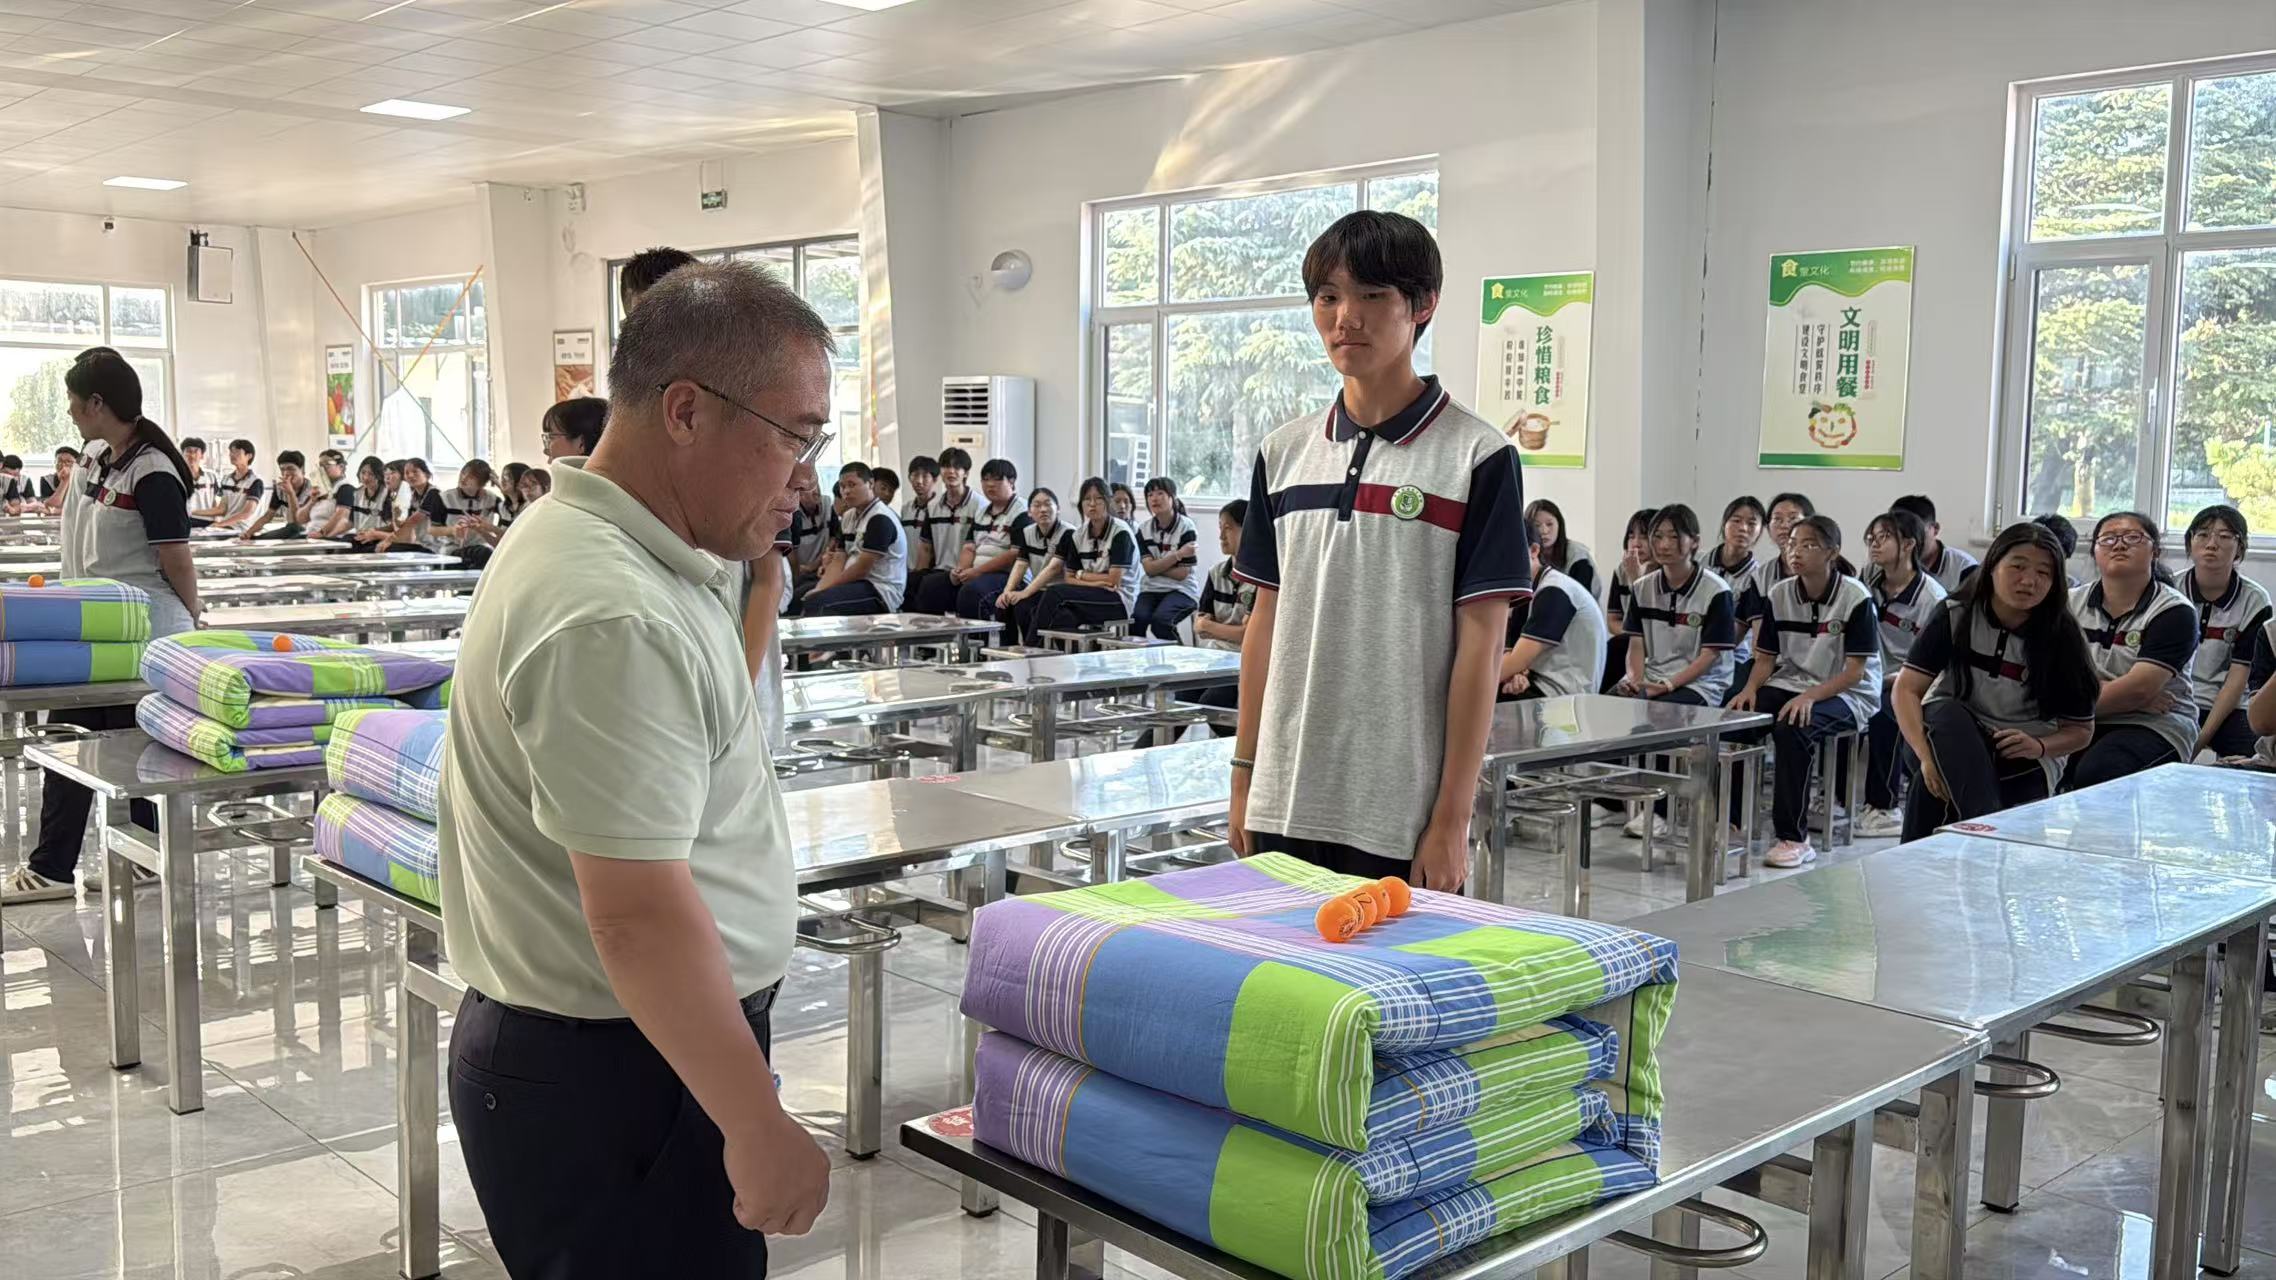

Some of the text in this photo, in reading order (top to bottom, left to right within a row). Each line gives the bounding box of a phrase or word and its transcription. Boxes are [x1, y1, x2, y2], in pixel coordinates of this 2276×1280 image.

[1534, 325, 1553, 405] 珍惜粮食
[1835, 306, 1862, 398] 文明用餐
